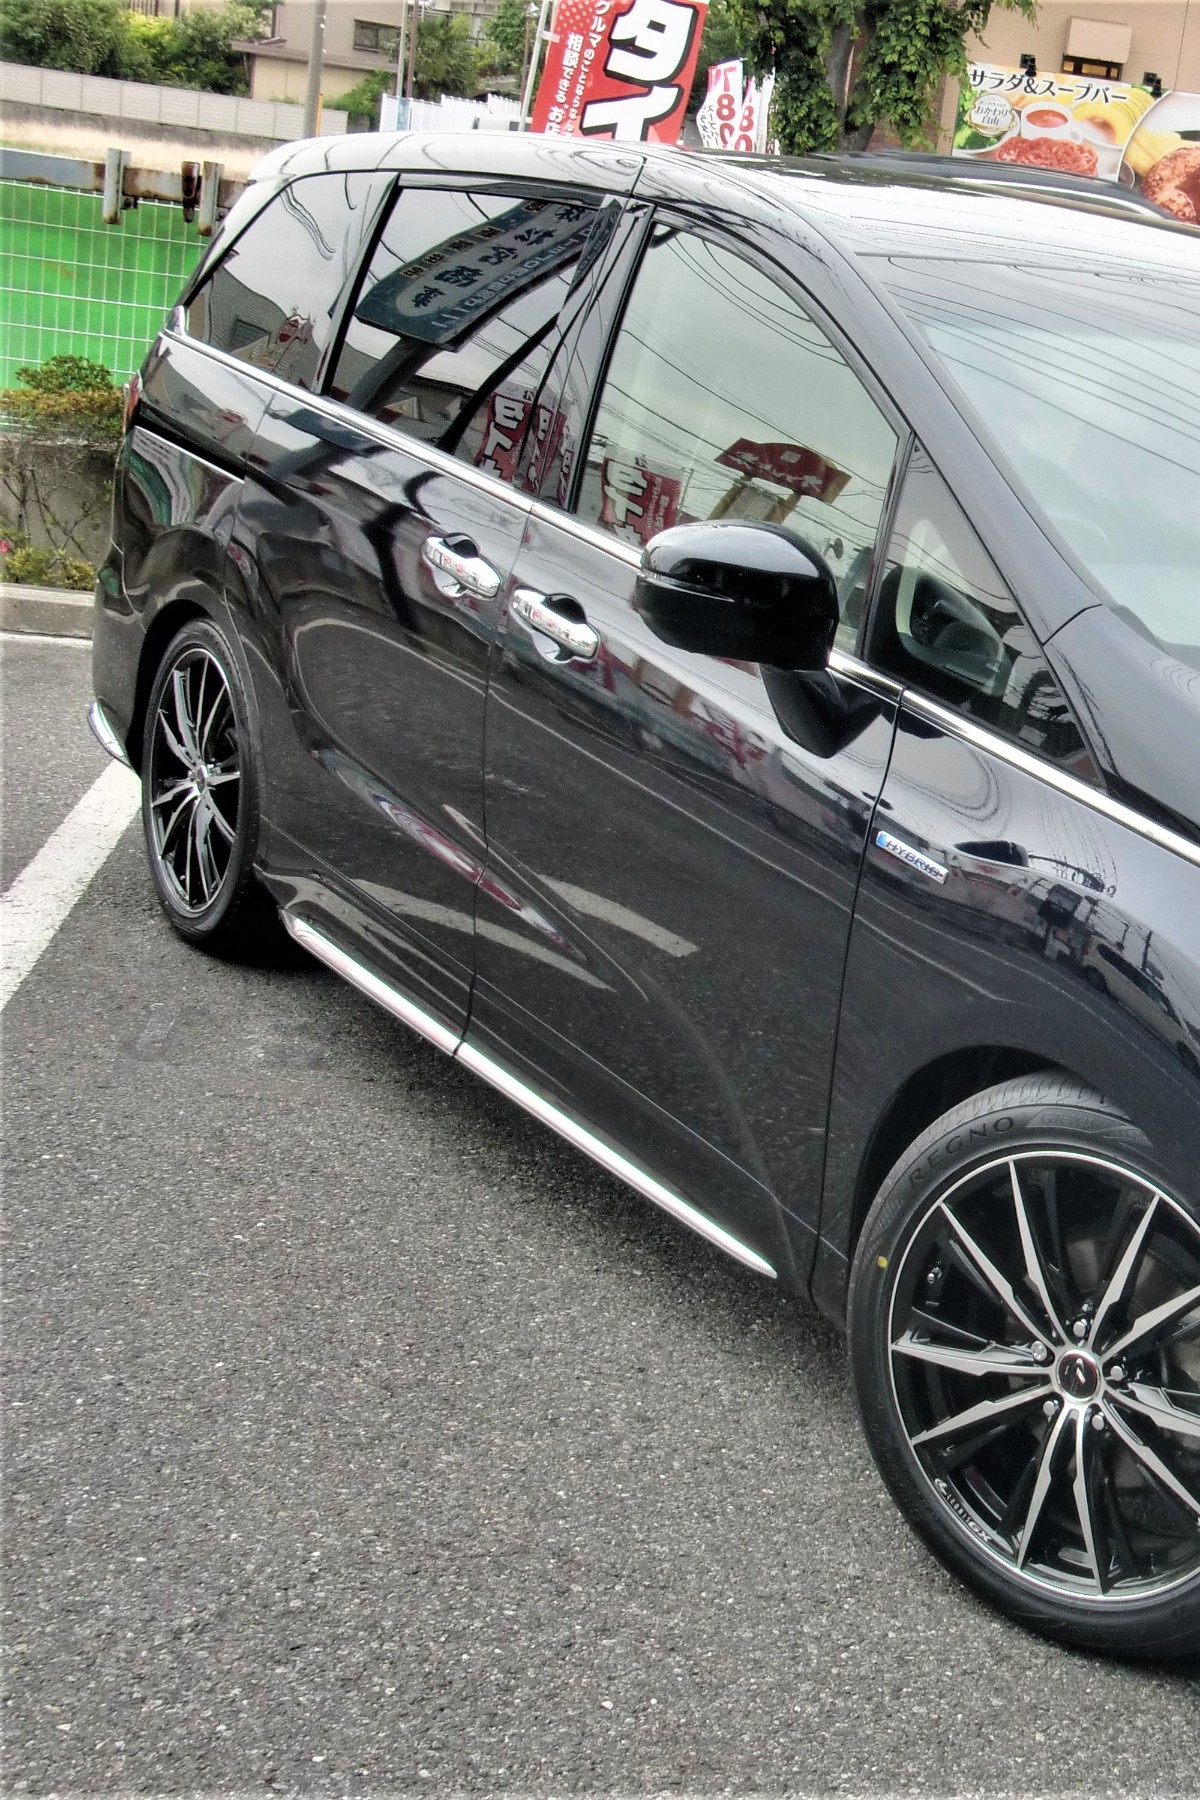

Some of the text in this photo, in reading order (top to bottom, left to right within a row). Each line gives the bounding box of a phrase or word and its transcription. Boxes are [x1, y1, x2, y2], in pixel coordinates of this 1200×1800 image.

[969, 68, 1128, 104] サラダ&スープバー
[886, 840, 942, 878] HYBRID
[908, 1115, 1015, 1190] REGNO
